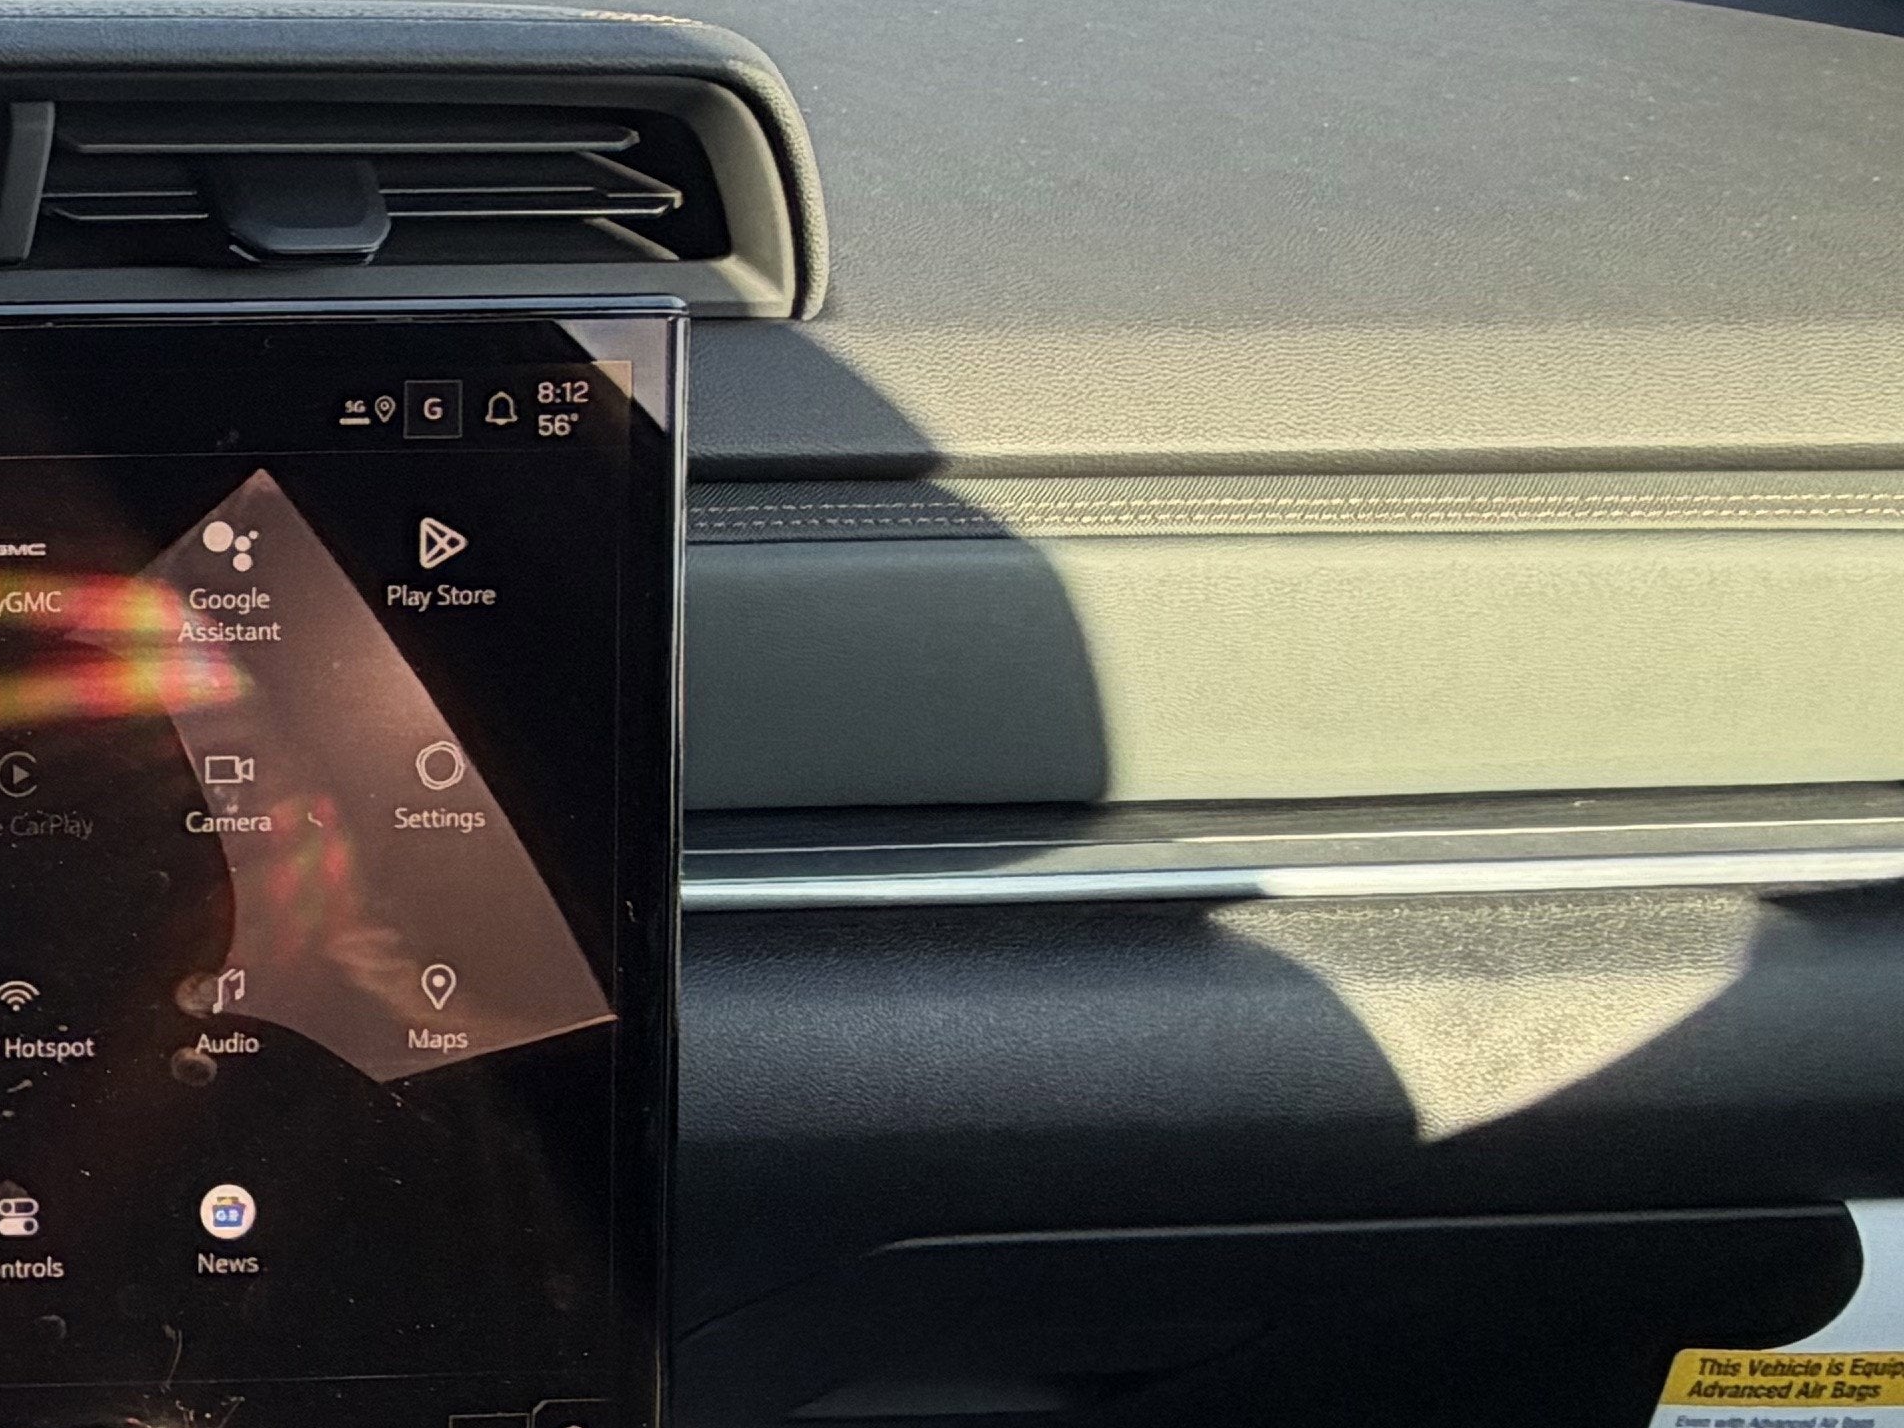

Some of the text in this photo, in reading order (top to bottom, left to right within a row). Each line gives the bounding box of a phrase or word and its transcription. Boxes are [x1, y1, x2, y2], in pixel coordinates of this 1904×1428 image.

[536, 381, 589, 405] 8:12
[423, 398, 443, 420] G
[537, 413, 580, 437] 56°
[189, 587, 271, 615] Google
[387, 584, 497, 609] Play Store
[177, 621, 281, 643] Assistant
[10, 815, 94, 840] CarPlay
[185, 811, 273, 833] Camera
[394, 807, 487, 832] Settings
[4, 1036, 96, 1062] Hotspot
[195, 1033, 260, 1054] Audio
[408, 1028, 468, 1051] Maps
[197, 1253, 259, 1274] News
[1699, 1358, 1742, 1377] This
[1748, 1359, 1822, 1377] Vehicle
[1827, 1359, 1845, 1377] is
[1687, 1380, 1882, 1402] Advanced Air Bags
